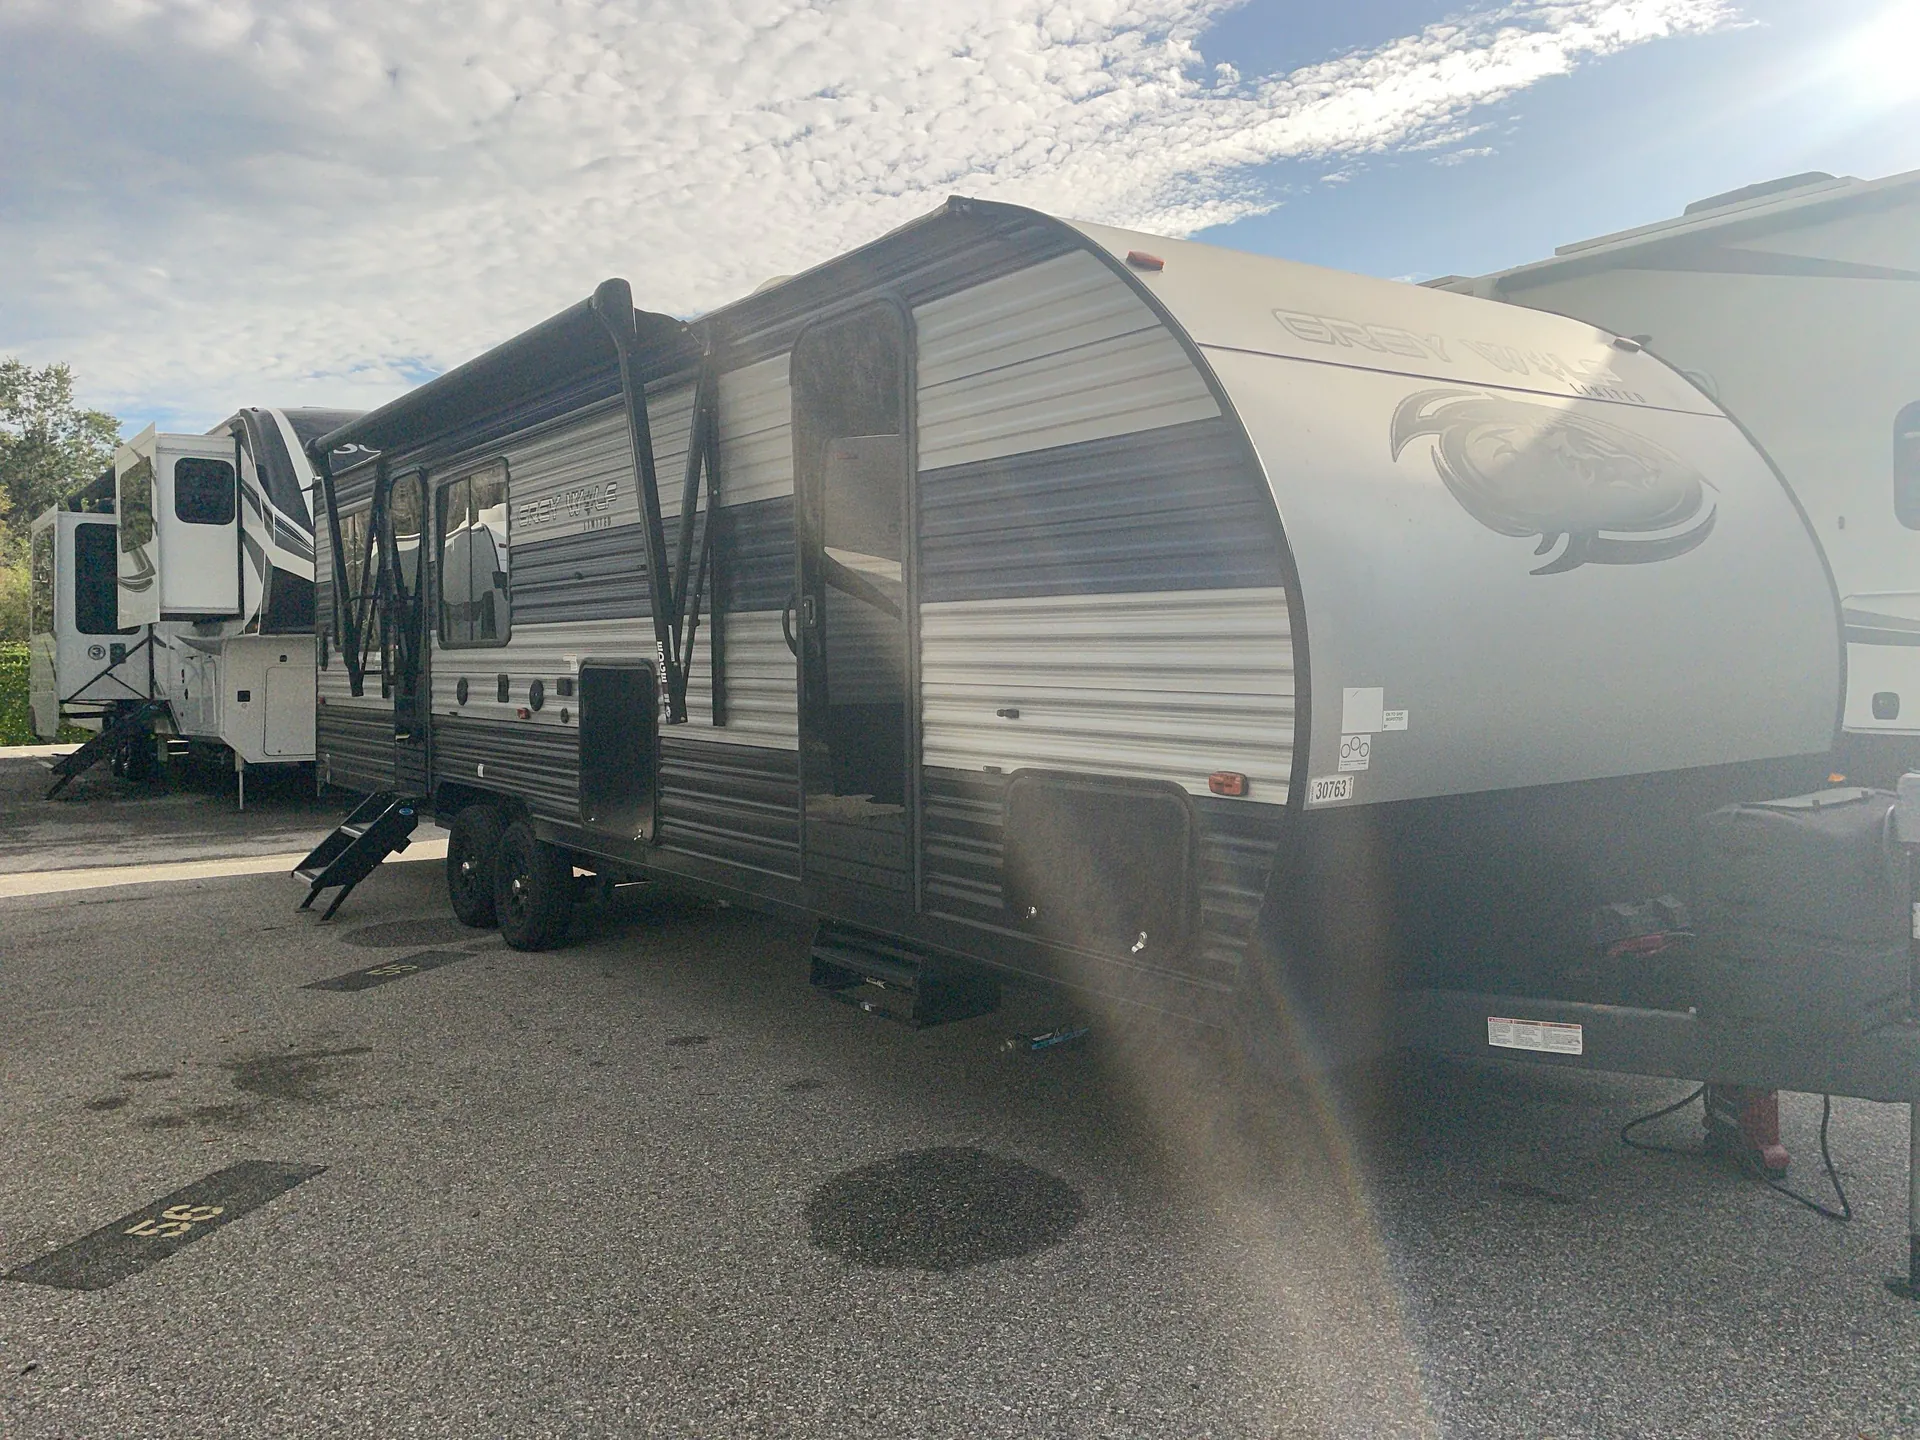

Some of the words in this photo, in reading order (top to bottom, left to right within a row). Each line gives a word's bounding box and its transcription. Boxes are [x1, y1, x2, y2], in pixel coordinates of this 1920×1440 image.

[1272, 308, 1452, 363] GREY
[1569, 382, 1647, 403] LIMITED
[583, 516, 612, 531] LIMITED
[656, 641, 668, 683] EDGE
[1315, 779, 1347, 800] 30763
